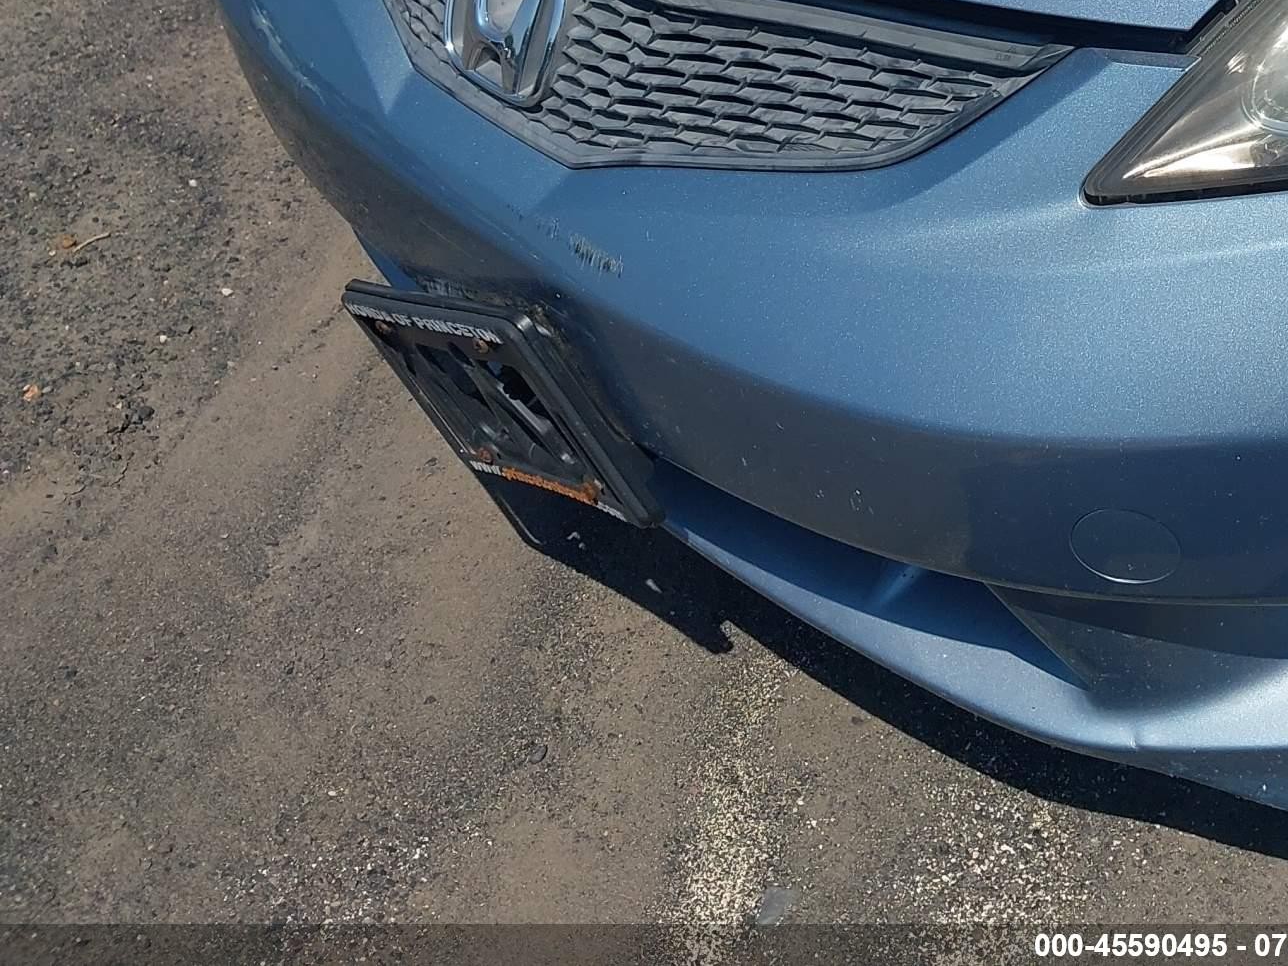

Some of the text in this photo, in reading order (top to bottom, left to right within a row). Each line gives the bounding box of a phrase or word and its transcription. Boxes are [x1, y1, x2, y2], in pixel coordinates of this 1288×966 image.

[344, 302, 504, 345] HONDA OF PRINCETON
